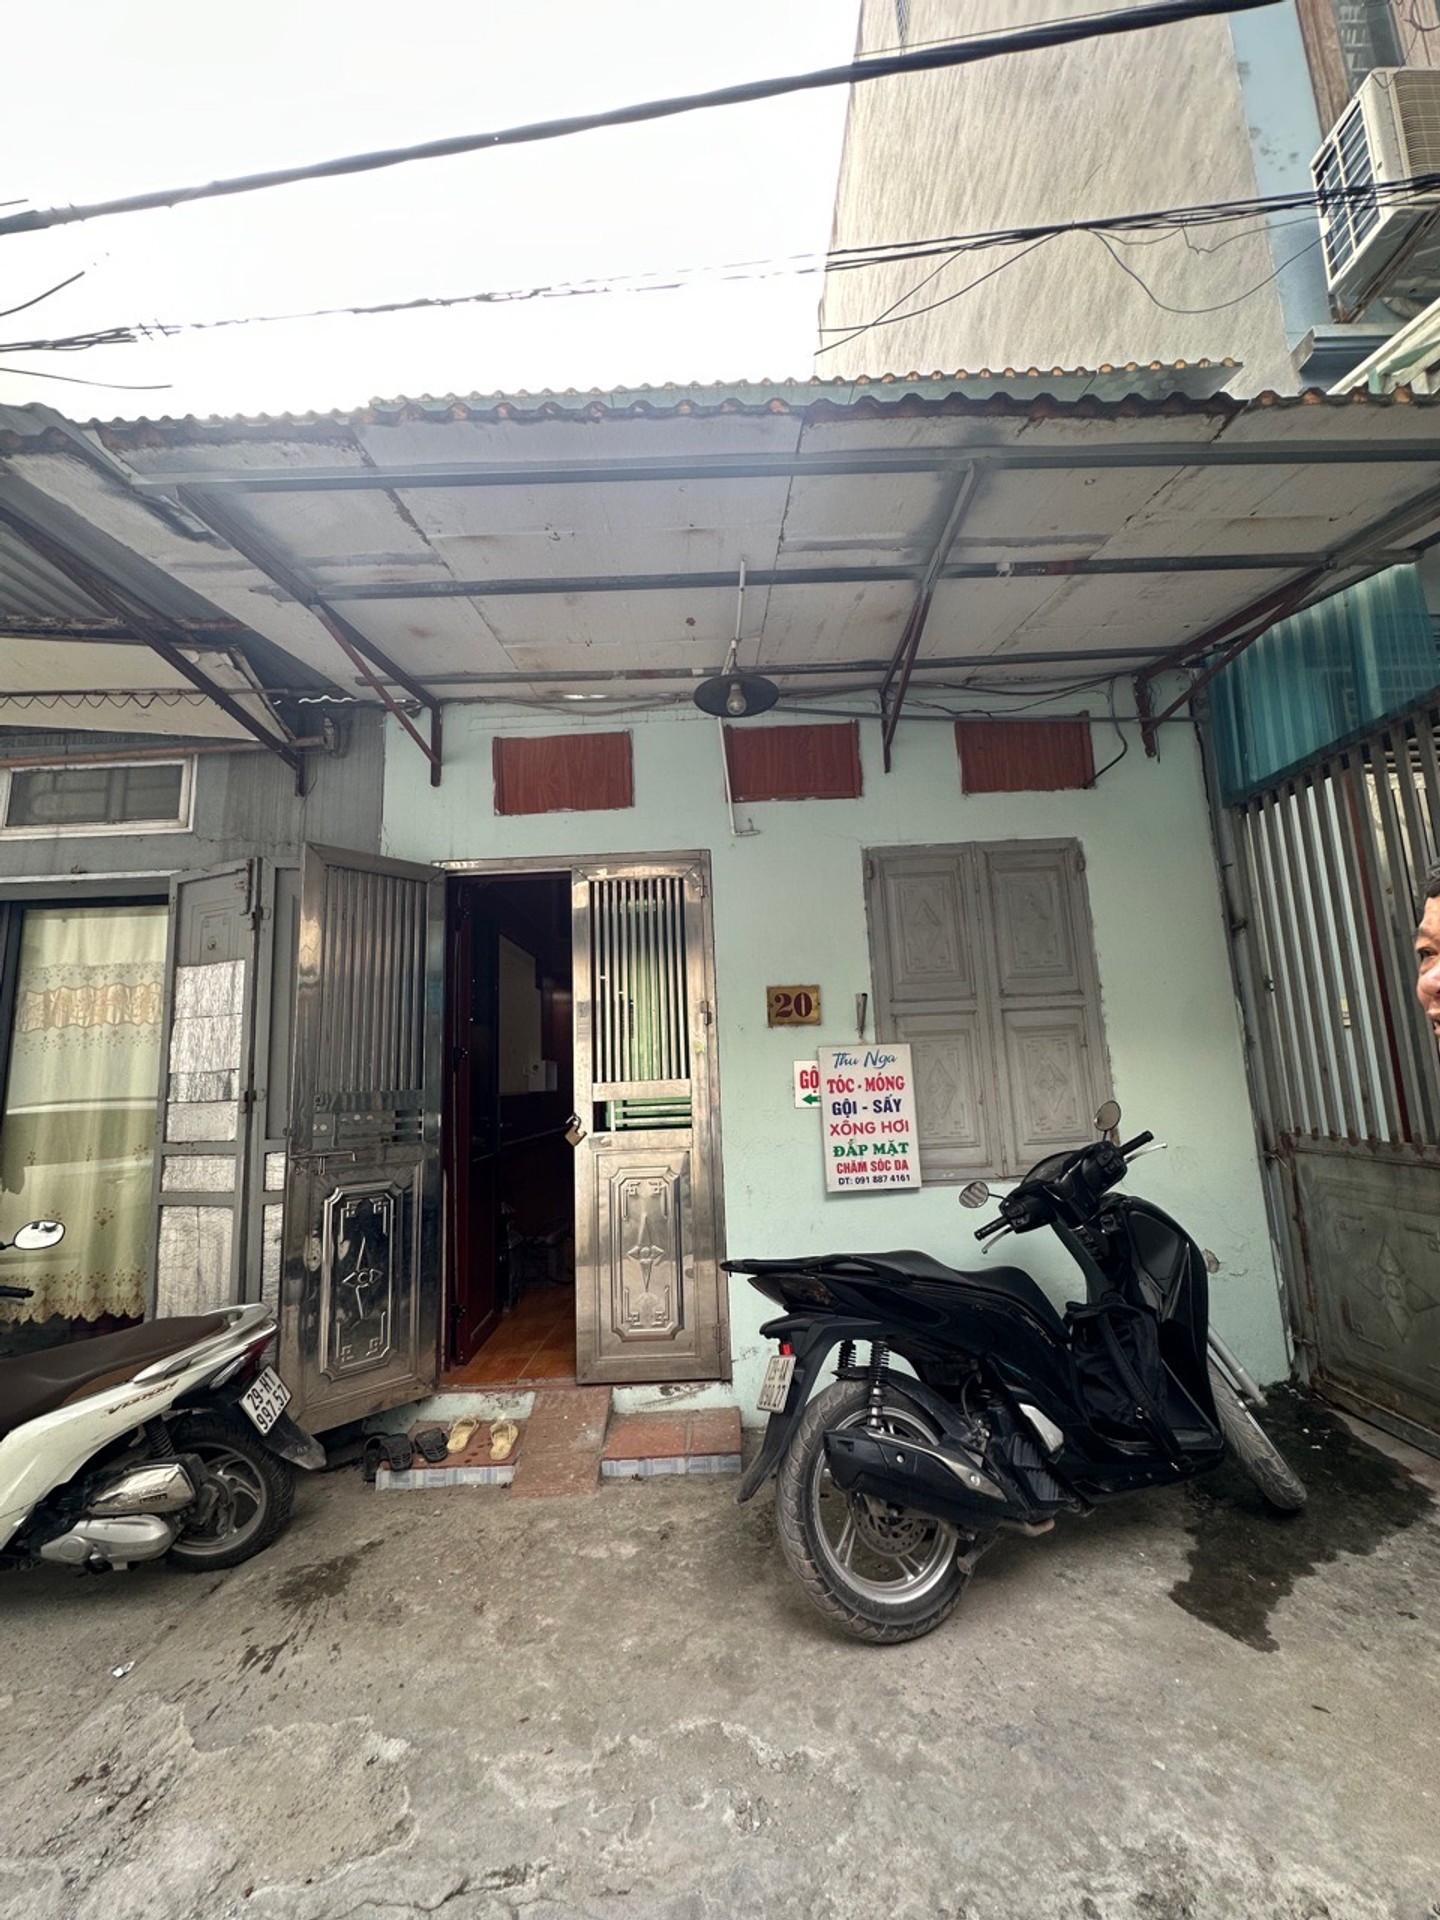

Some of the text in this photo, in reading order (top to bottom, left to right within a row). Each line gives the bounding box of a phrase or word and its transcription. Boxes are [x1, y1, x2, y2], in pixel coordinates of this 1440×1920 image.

[774, 992, 812, 1018] 20
[832, 1049, 897, 1069] Thu Nga
[800, 1065, 819, 1093] GỘ
[827, 1074, 855, 1094] TÓC
[864, 1072, 905, 1092] MÓNG
[832, 1098, 857, 1118] GỘI
[873, 1094, 902, 1114] SẤY
[830, 1119, 909, 1136] XÔNG HƠI
[833, 1138, 909, 1157] ĐẮP MẶT
[837, 1158, 909, 1174] CHĂM SÓC DA
[854, 1176, 870, 1184] 091
[872, 1175, 887, 1183] 887
[247, 1372, 276, 1411] 29-H1
[256, 1384, 288, 1429] 997.57
